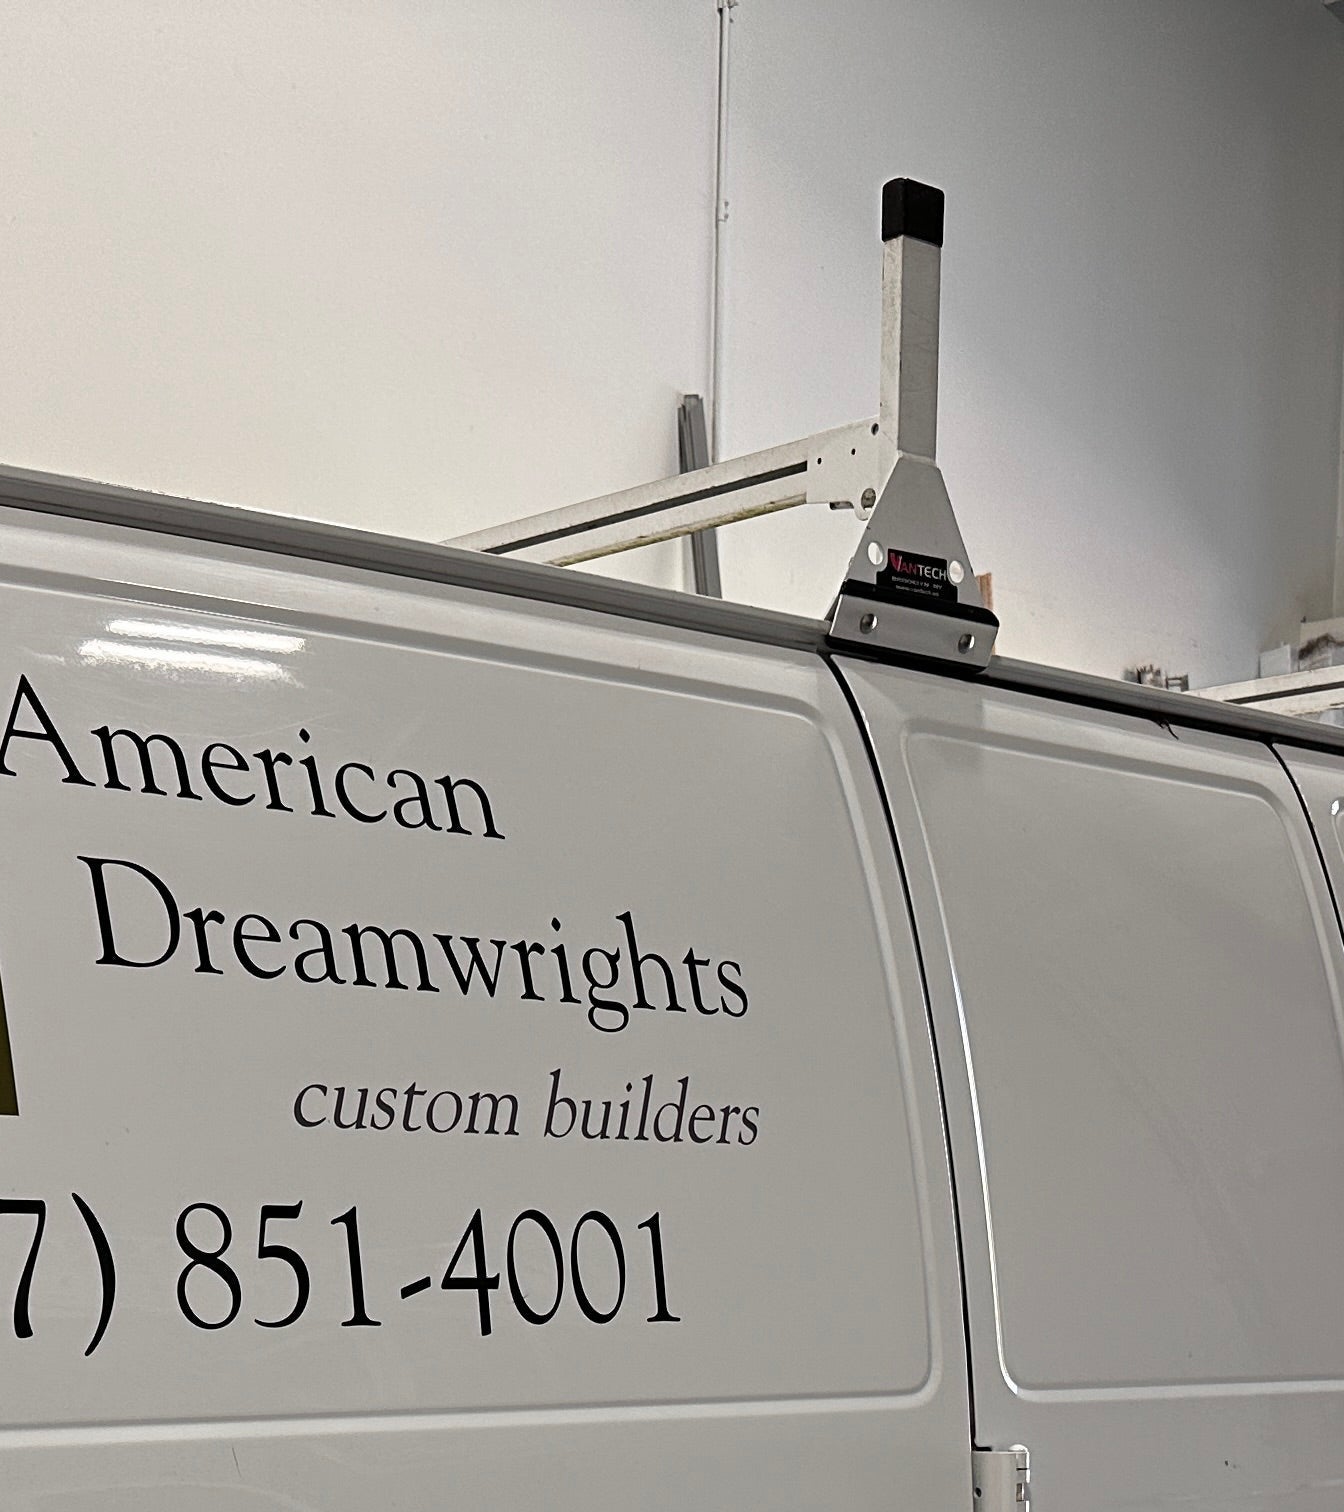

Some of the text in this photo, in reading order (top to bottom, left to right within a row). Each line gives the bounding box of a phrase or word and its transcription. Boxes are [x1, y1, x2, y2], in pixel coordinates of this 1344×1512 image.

[889, 552, 947, 581] VANTECH
[77, 856, 748, 1032] Dreamwrights
[294, 1069, 759, 1145] custom builders
[176, 1200, 680, 1336] 851-4001
